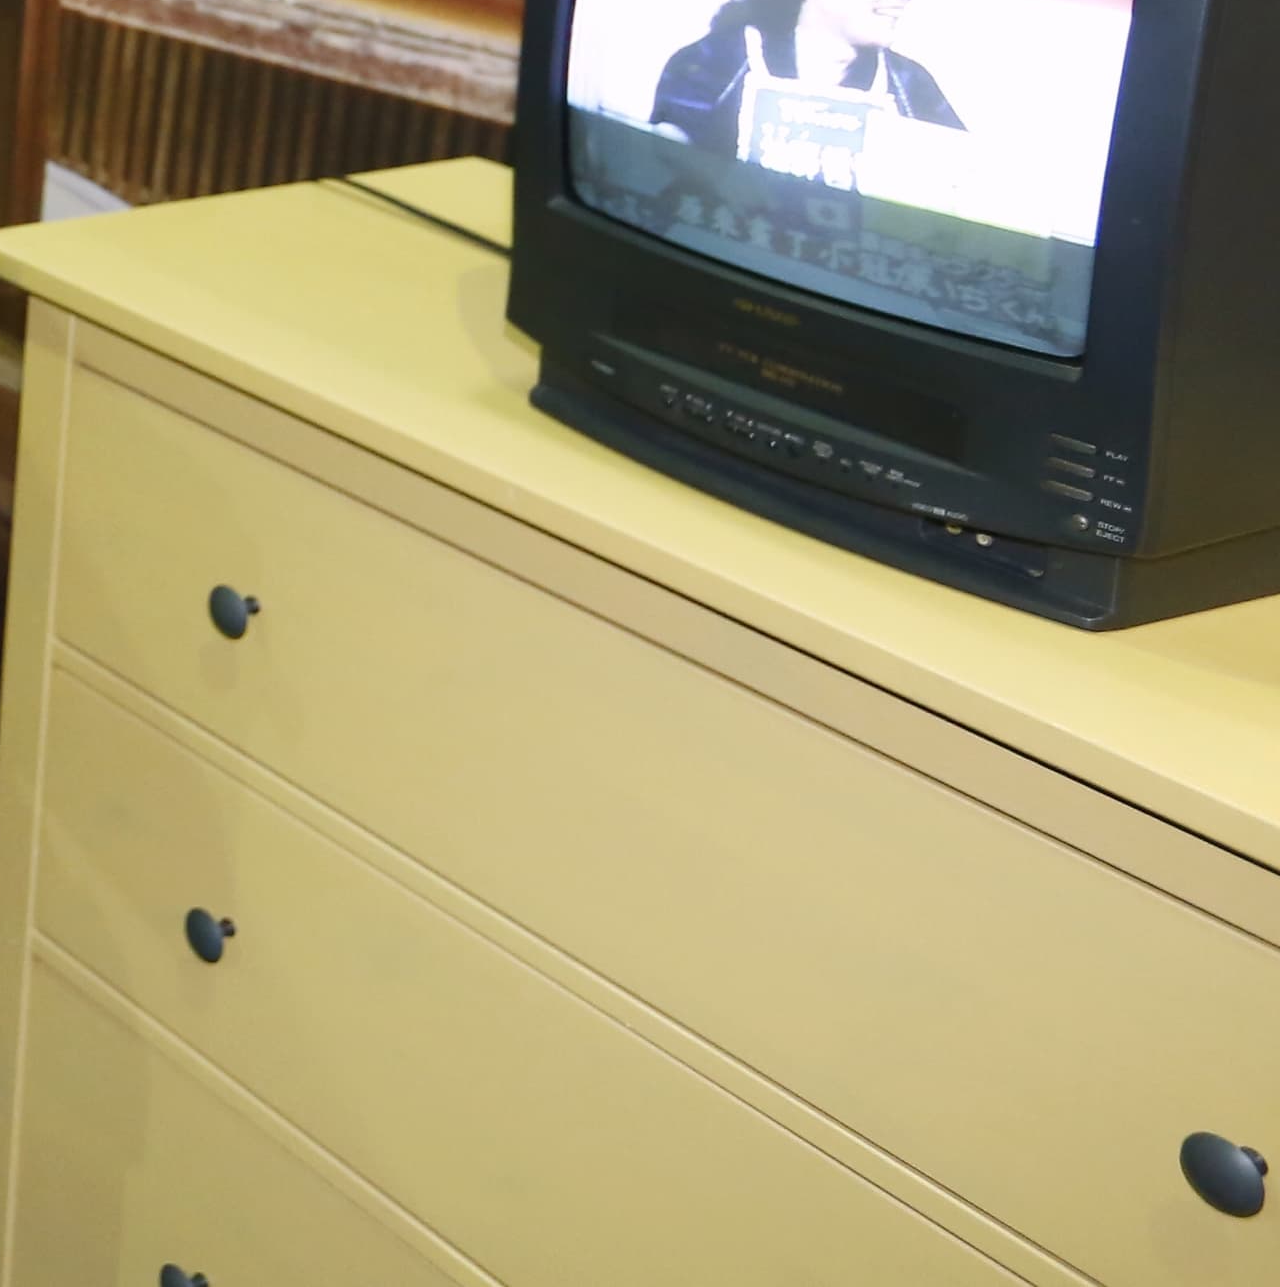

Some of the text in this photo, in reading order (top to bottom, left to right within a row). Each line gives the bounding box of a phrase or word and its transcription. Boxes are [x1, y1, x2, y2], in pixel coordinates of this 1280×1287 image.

[1105, 451, 1128, 461] PLAY
[1100, 498, 1122, 510] REW
[1096, 529, 1125, 543] EJECT
